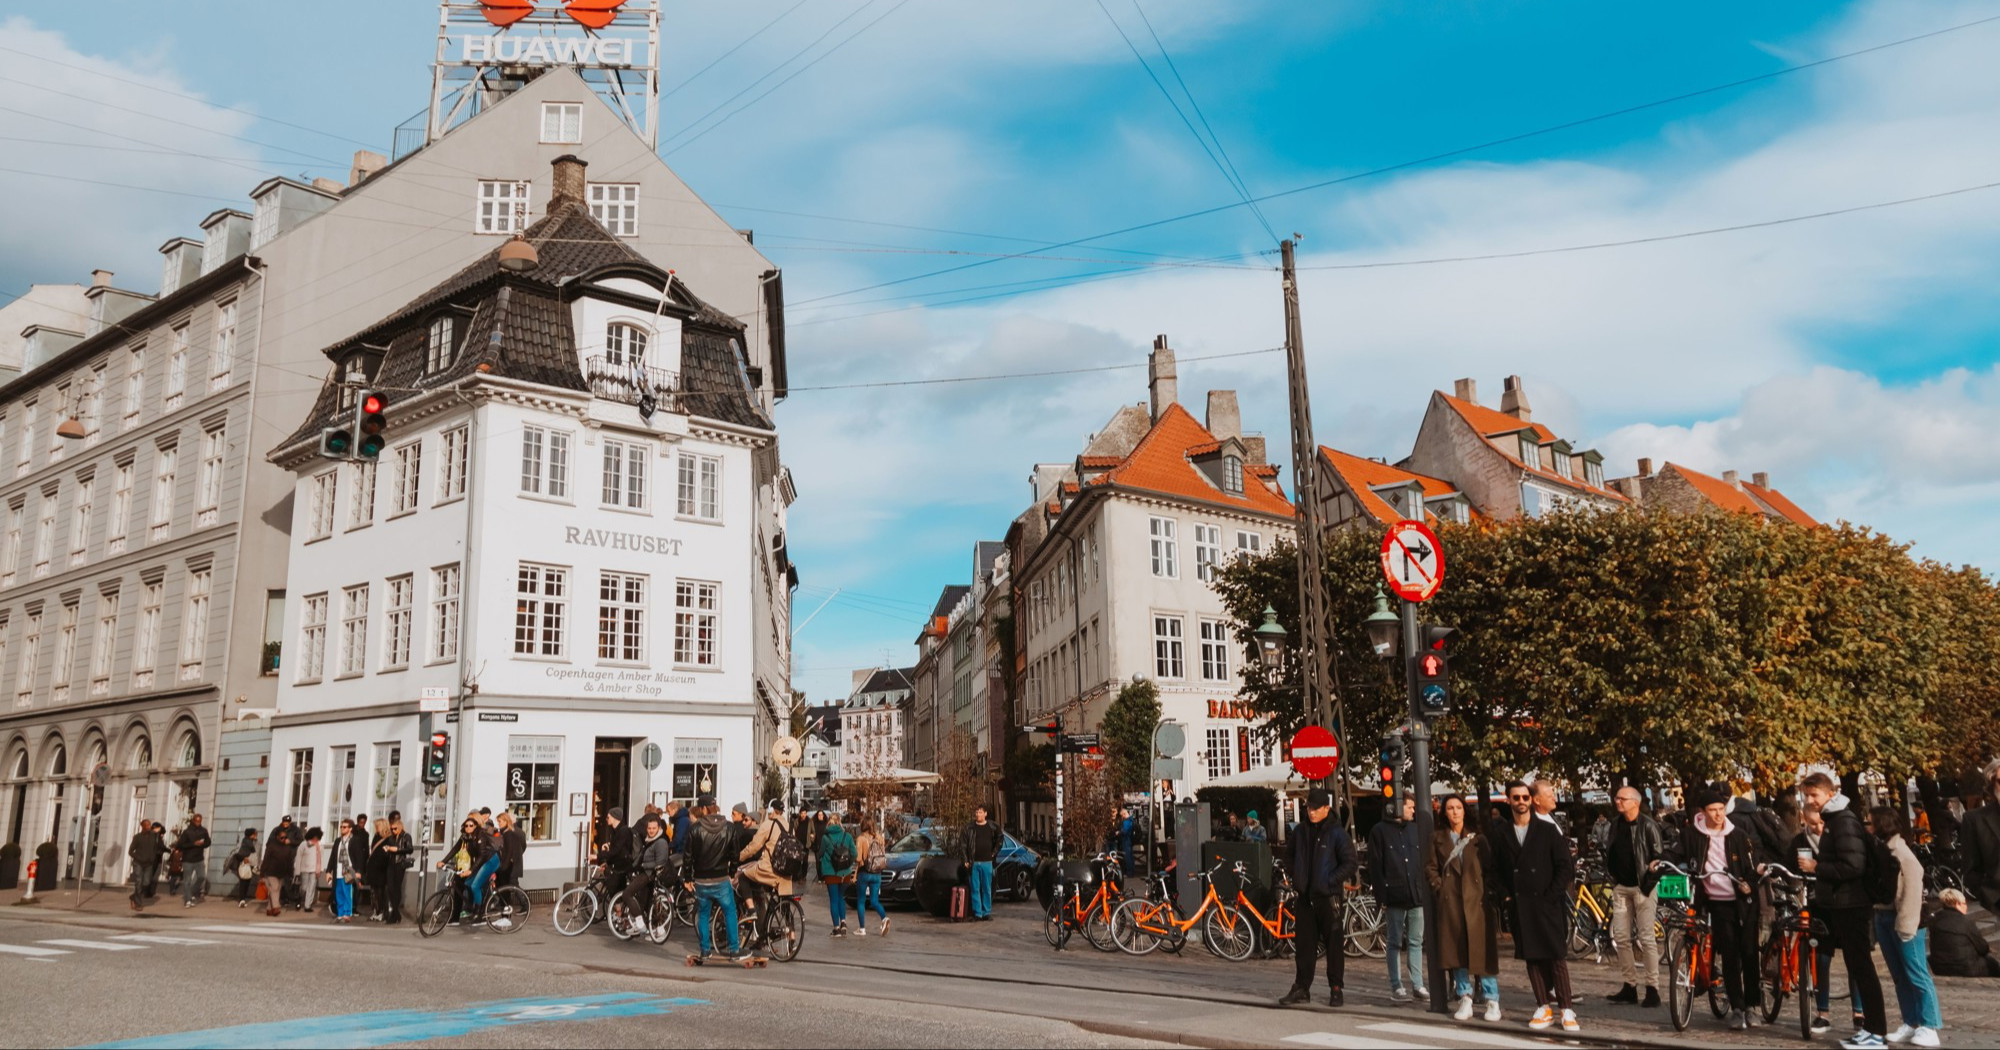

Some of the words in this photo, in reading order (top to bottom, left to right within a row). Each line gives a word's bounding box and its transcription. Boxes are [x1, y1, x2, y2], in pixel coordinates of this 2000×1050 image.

[463, 34, 632, 65] HUAWEI
[565, 526, 683, 556] RAVHUSET
[545, 667, 614, 682] Copenhagen
[617, 671, 652, 682] Amber
[654, 673, 696, 684] Museum
[583, 682, 594, 692] &
[597, 683, 632, 693] Amber
[635, 684, 662, 696] Shop
